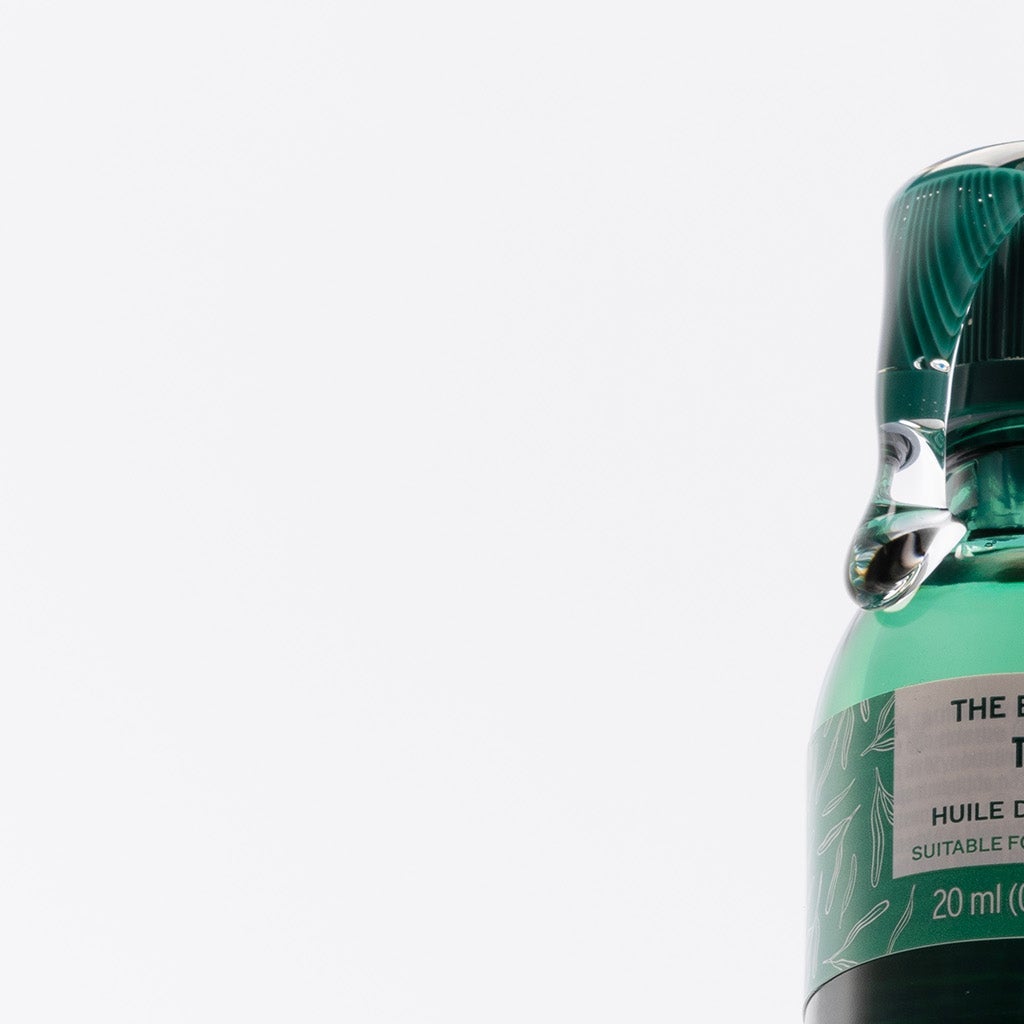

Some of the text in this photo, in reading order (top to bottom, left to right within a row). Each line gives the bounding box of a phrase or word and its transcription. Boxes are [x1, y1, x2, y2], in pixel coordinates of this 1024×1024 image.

[951, 696, 1006, 722] THE
[932, 801, 1004, 826] HUILE
[912, 836, 1002, 861] SUITABLE
[933, 887, 963, 919] 20
[971, 883, 1001, 915] ml
